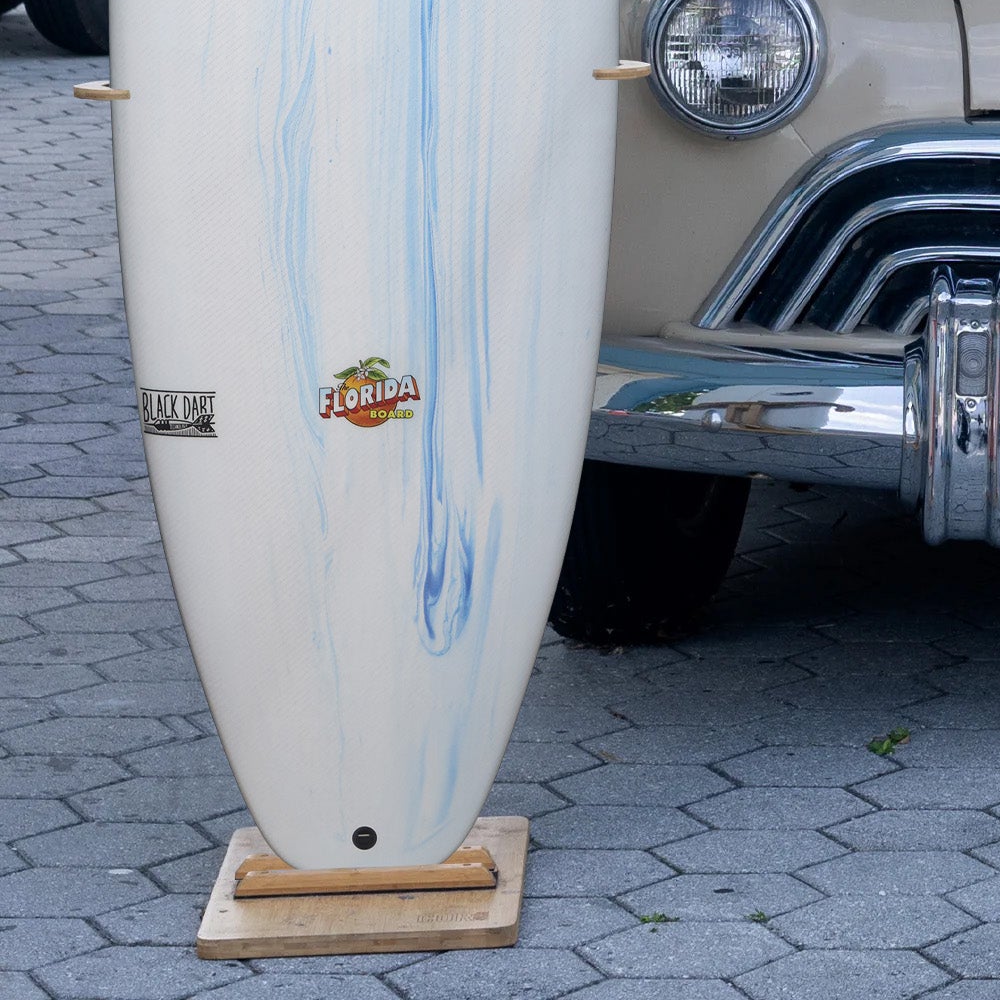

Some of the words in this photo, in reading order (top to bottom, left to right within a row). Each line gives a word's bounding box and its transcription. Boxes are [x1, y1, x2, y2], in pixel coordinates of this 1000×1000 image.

[142, 392, 179, 422] BLACK
[183, 395, 215, 420] DART
[319, 375, 421, 418] FLORIDA
[369, 409, 414, 419] BOARD
